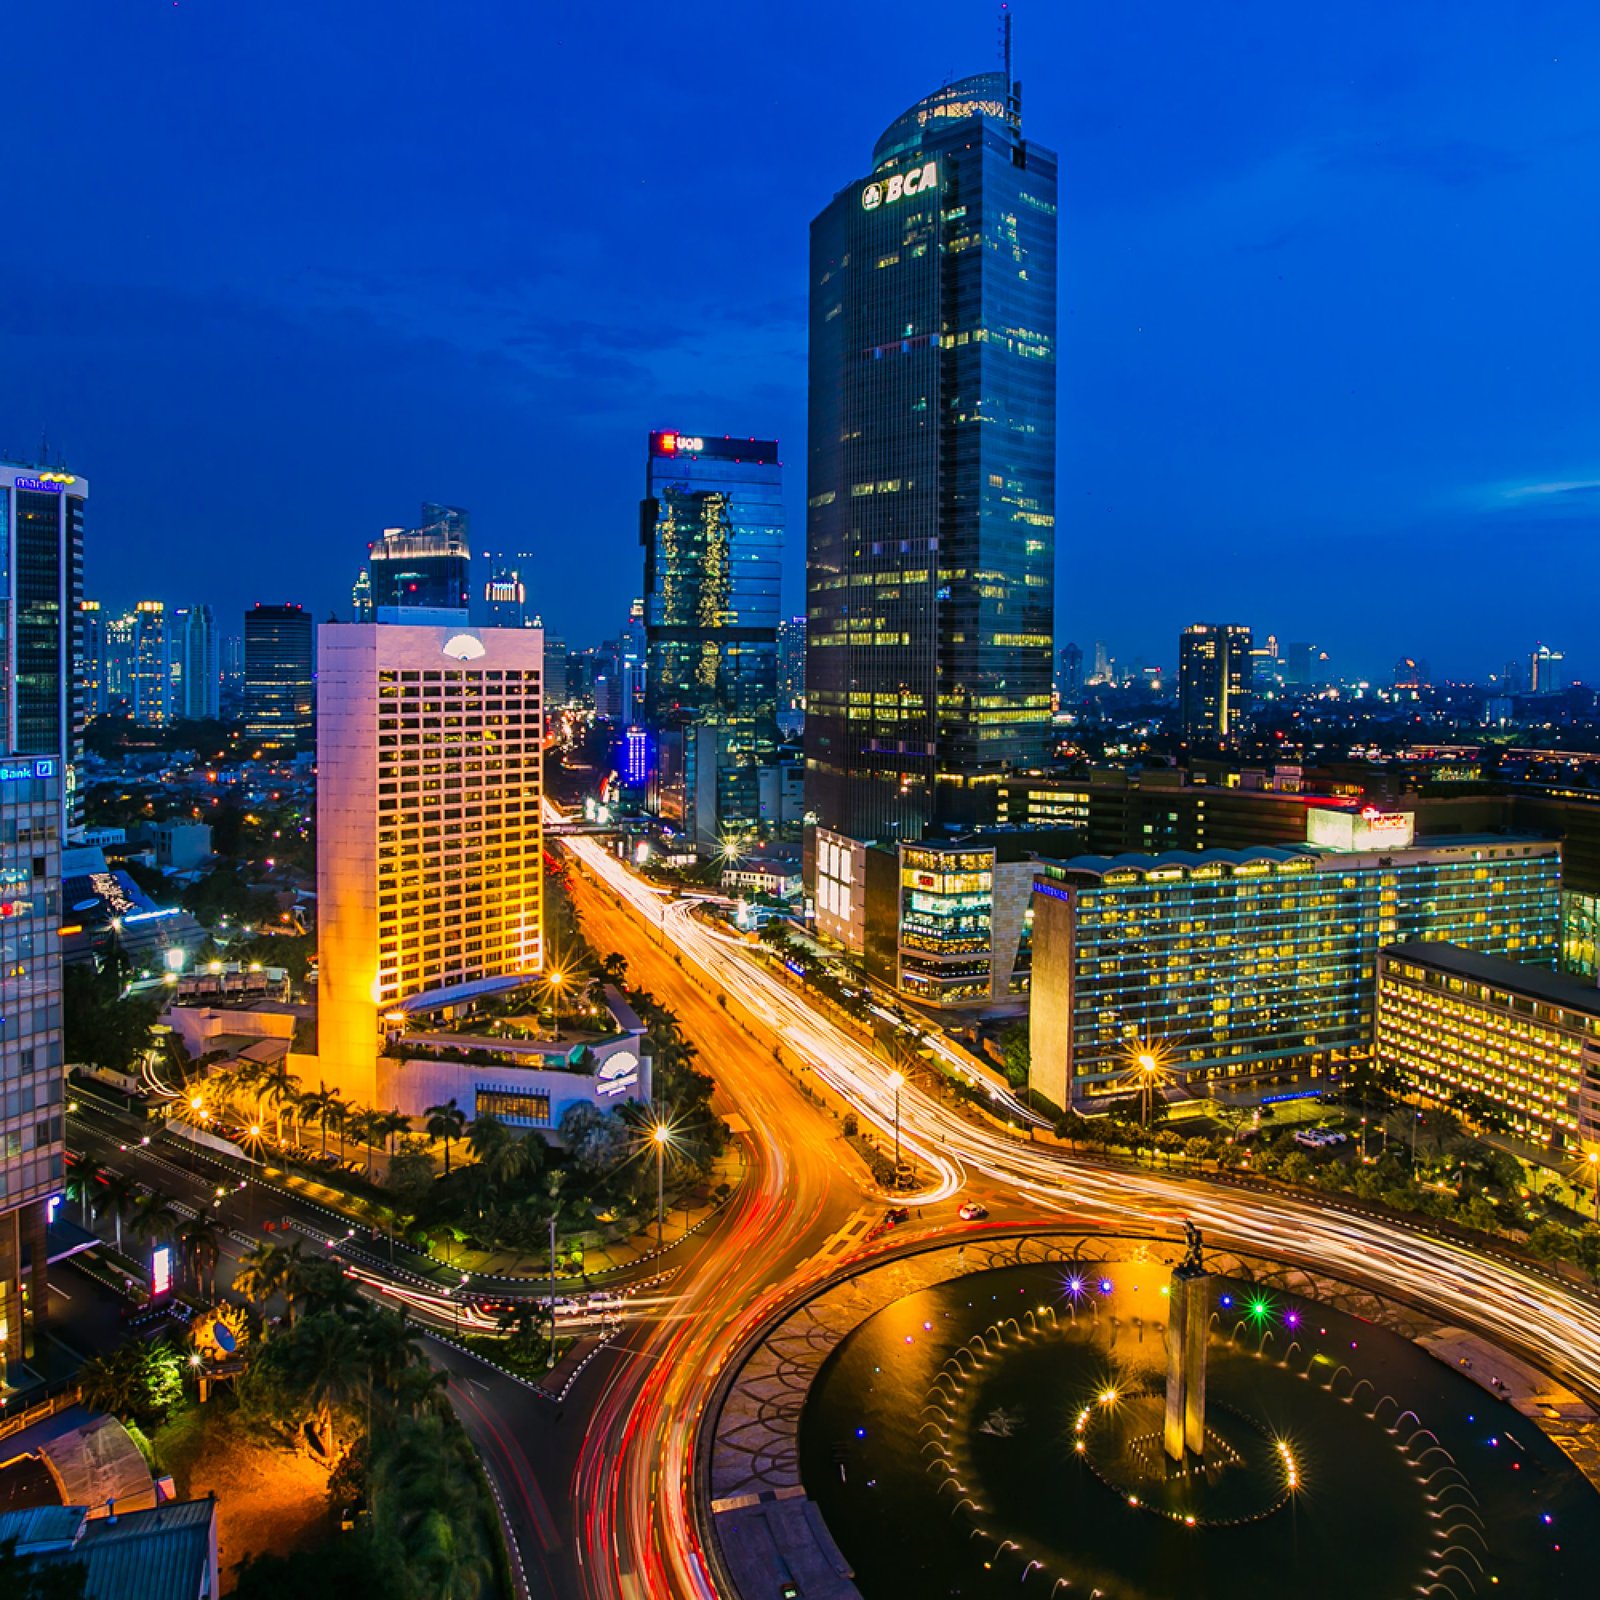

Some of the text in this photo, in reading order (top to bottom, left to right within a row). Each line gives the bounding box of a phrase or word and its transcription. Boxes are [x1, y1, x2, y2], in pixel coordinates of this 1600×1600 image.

[886, 162, 937, 203] BCA
[676, 436, 704, 451] UOB
[1, 767, 31, 780] Bank
